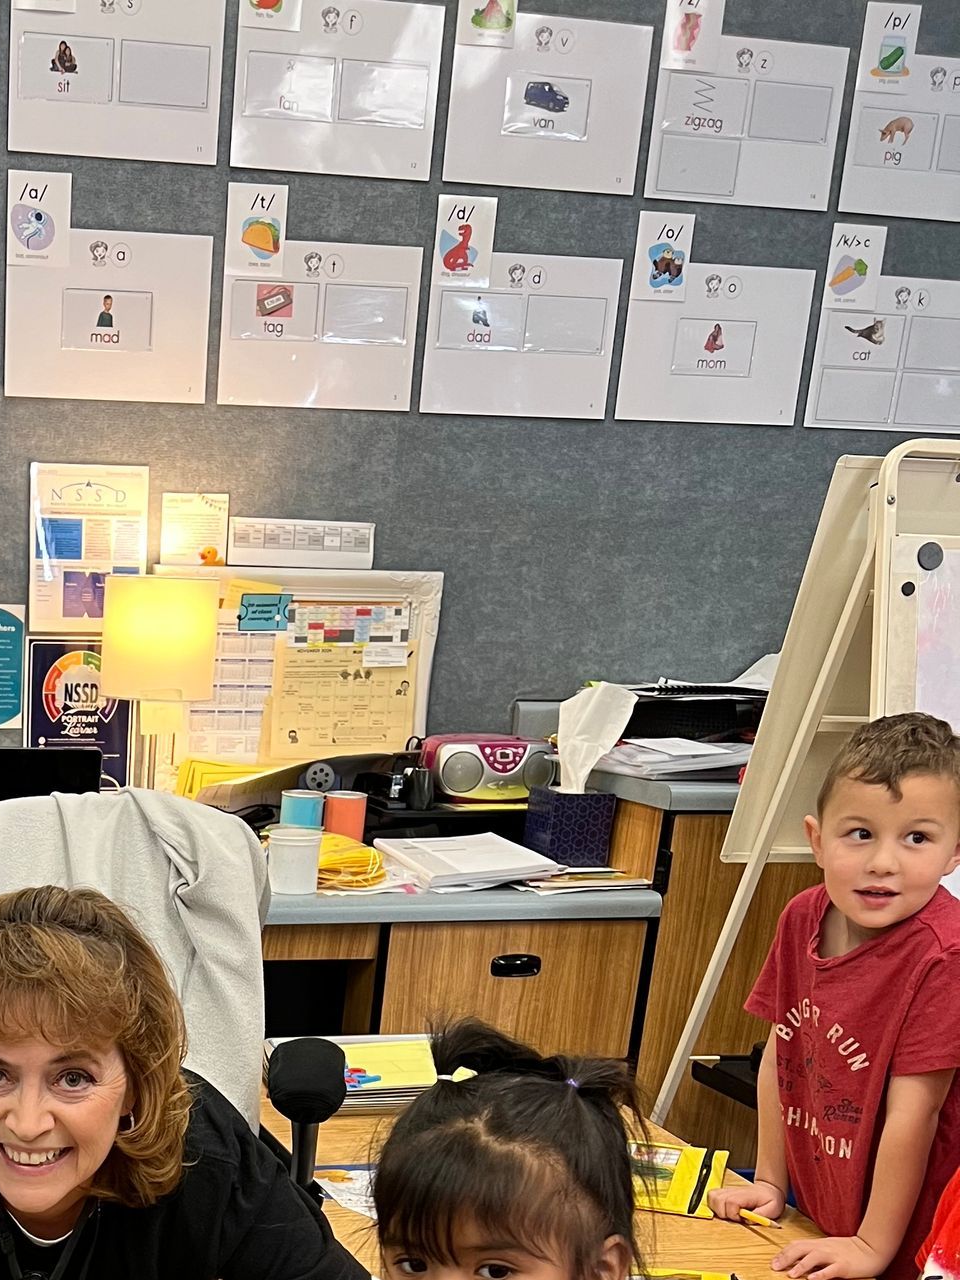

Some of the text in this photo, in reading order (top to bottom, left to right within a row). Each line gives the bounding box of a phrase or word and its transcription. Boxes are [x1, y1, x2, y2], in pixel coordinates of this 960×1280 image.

[349, 15, 356, 29] f
[884, 11, 911, 30] /p/
[559, 36, 568, 47] v
[760, 59, 767, 69] z
[57, 79, 71, 93] sit
[278, 96, 299, 113] fan
[532, 117, 555, 130] van
[685, 115, 723, 133] zigzag
[884, 150, 902, 165] pig
[19, 183, 48, 202] /a/
[251, 194, 275, 211] /t/
[448, 205, 475, 222] /d/
[657, 224, 683, 241] /o/
[116, 250, 125, 261] a
[330, 261, 336, 273] t
[533, 270, 542, 284] d
[729, 283, 736, 293] o
[918, 292, 925, 306] k
[263, 320, 284, 337] tag
[90, 330, 120, 344] mad
[467, 330, 491, 344] dad
[696, 356, 726, 369] mom
[852, 349, 870, 362] cat
[64, 682, 99, 703] NSSD
[61, 715, 100, 723] PORTRAIT
[826, 1022, 870, 1072] RUN
